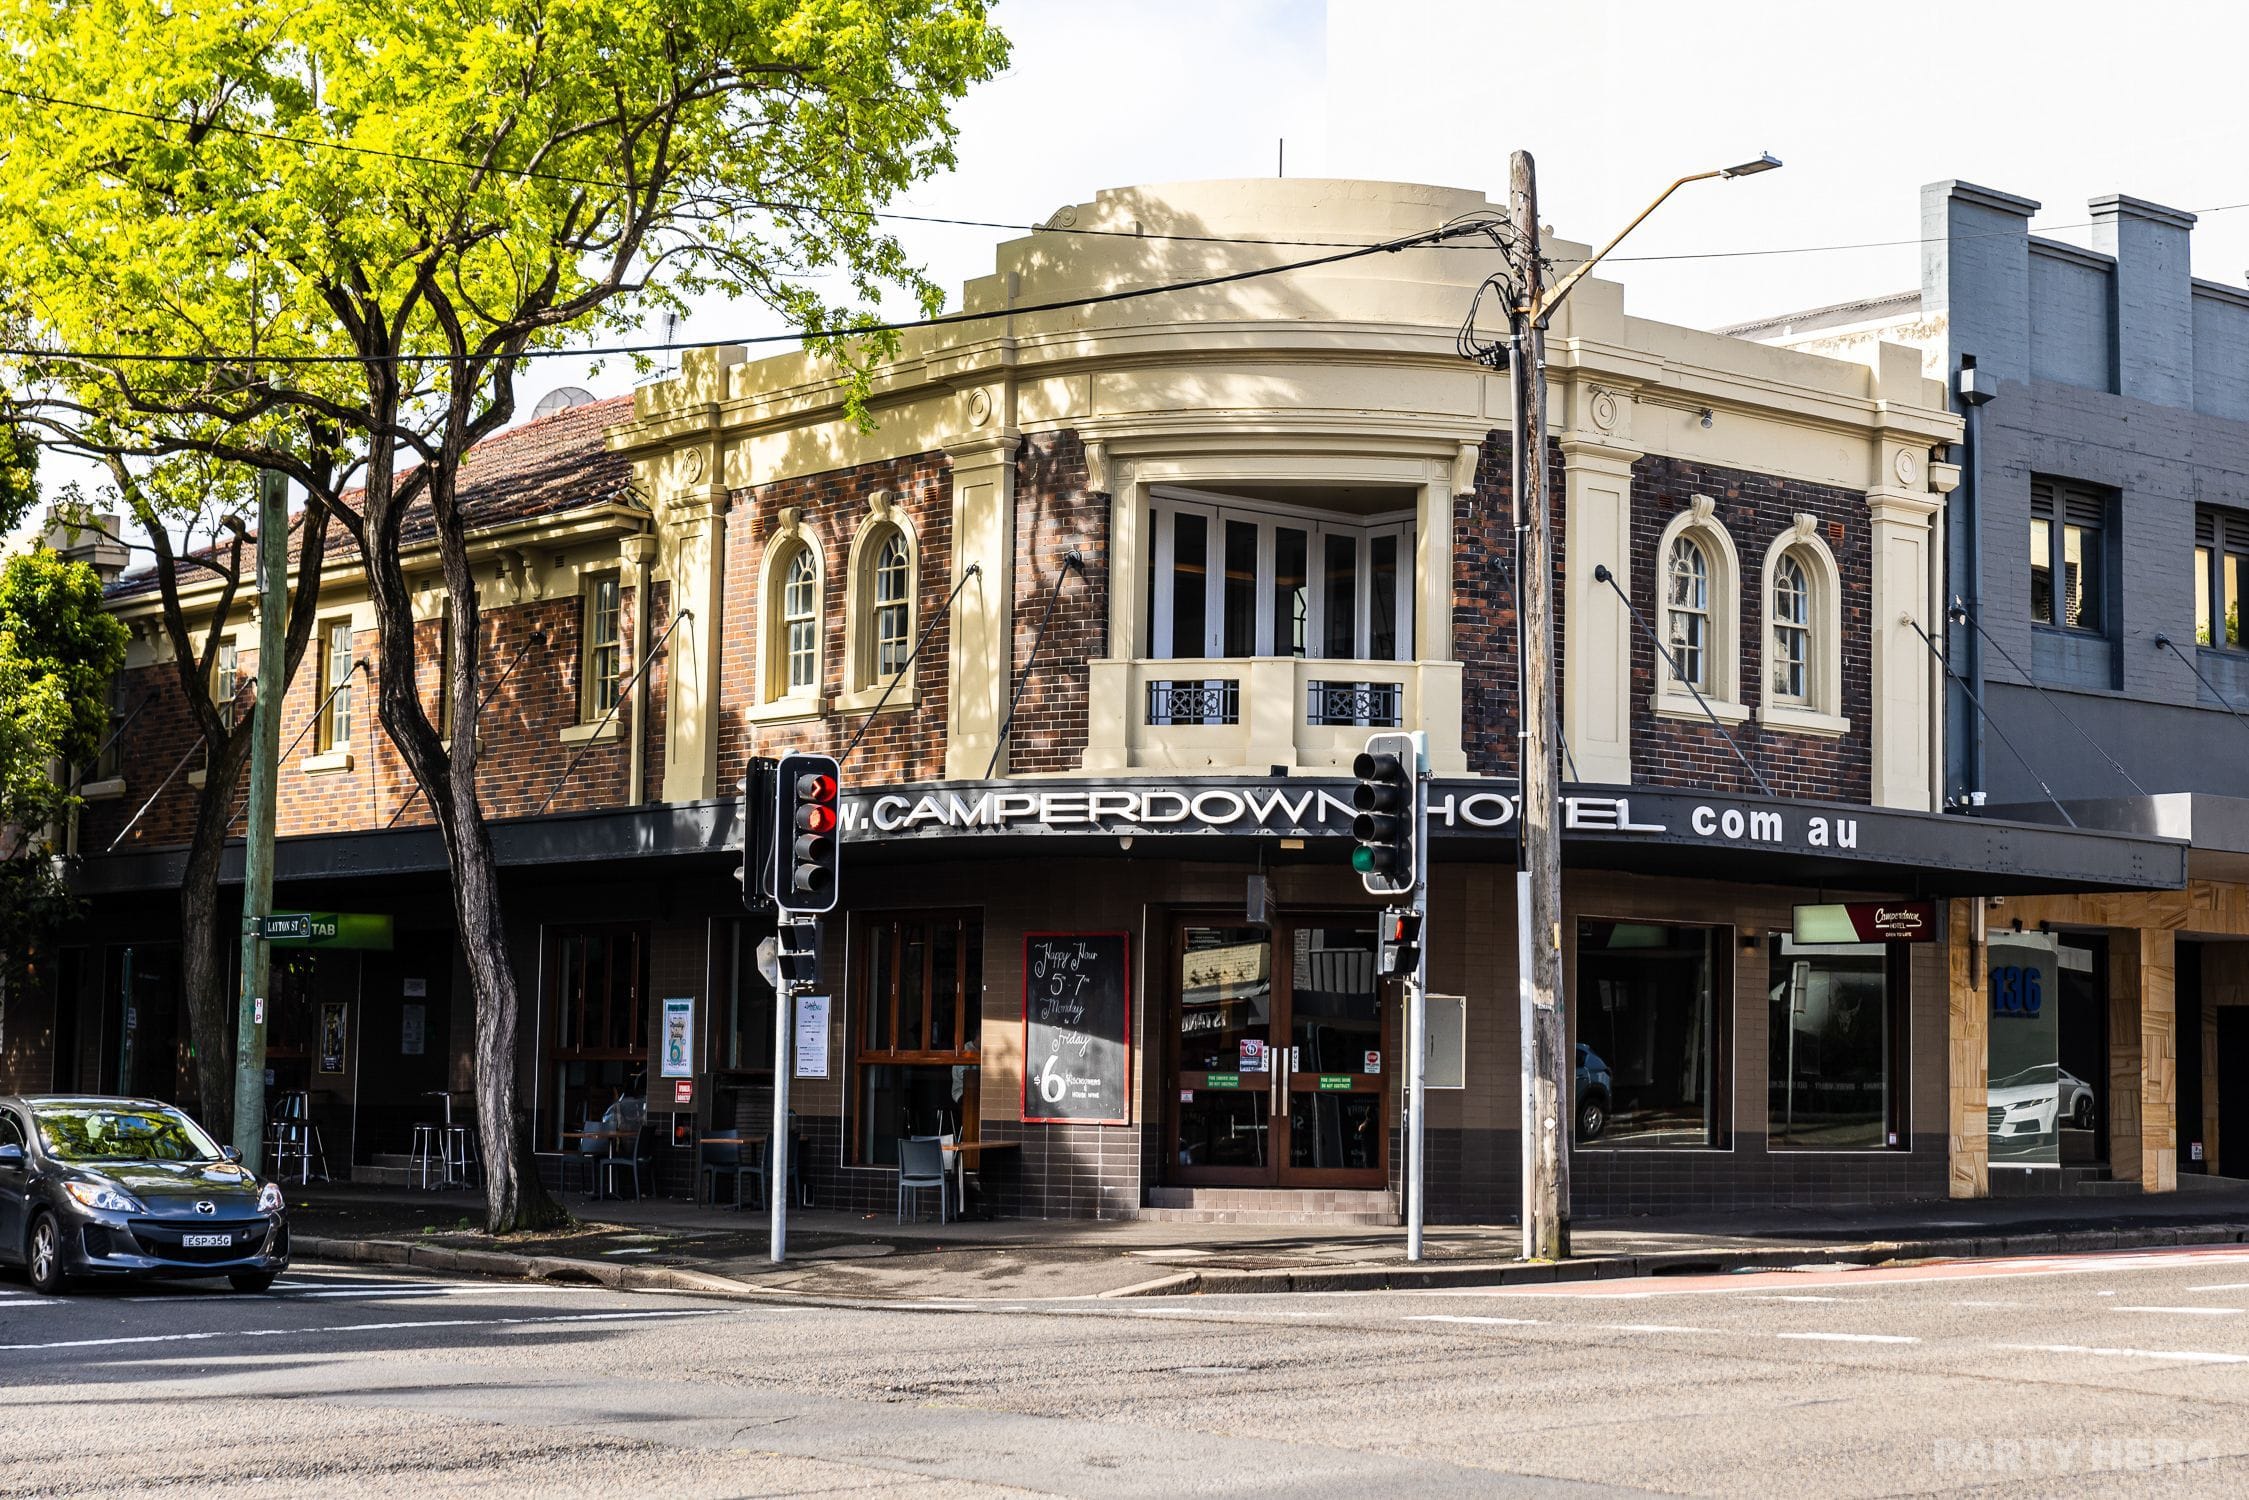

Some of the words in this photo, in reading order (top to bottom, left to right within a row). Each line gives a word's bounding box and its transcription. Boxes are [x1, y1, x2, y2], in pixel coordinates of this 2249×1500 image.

[1691, 806, 1782, 842] com
[1807, 816, 1858, 849] au
[267, 921, 290, 932] LAYTON
[290, 920, 298, 931] ST
[312, 923, 336, 936] TAB
[1035, 942, 1071, 978] Happy
[1071, 942, 1098, 971] Hour
[1991, 966, 2042, 1010] 136
[1040, 998, 1086, 1024] Monday
[1051, 1026, 1092, 1057] Friday
